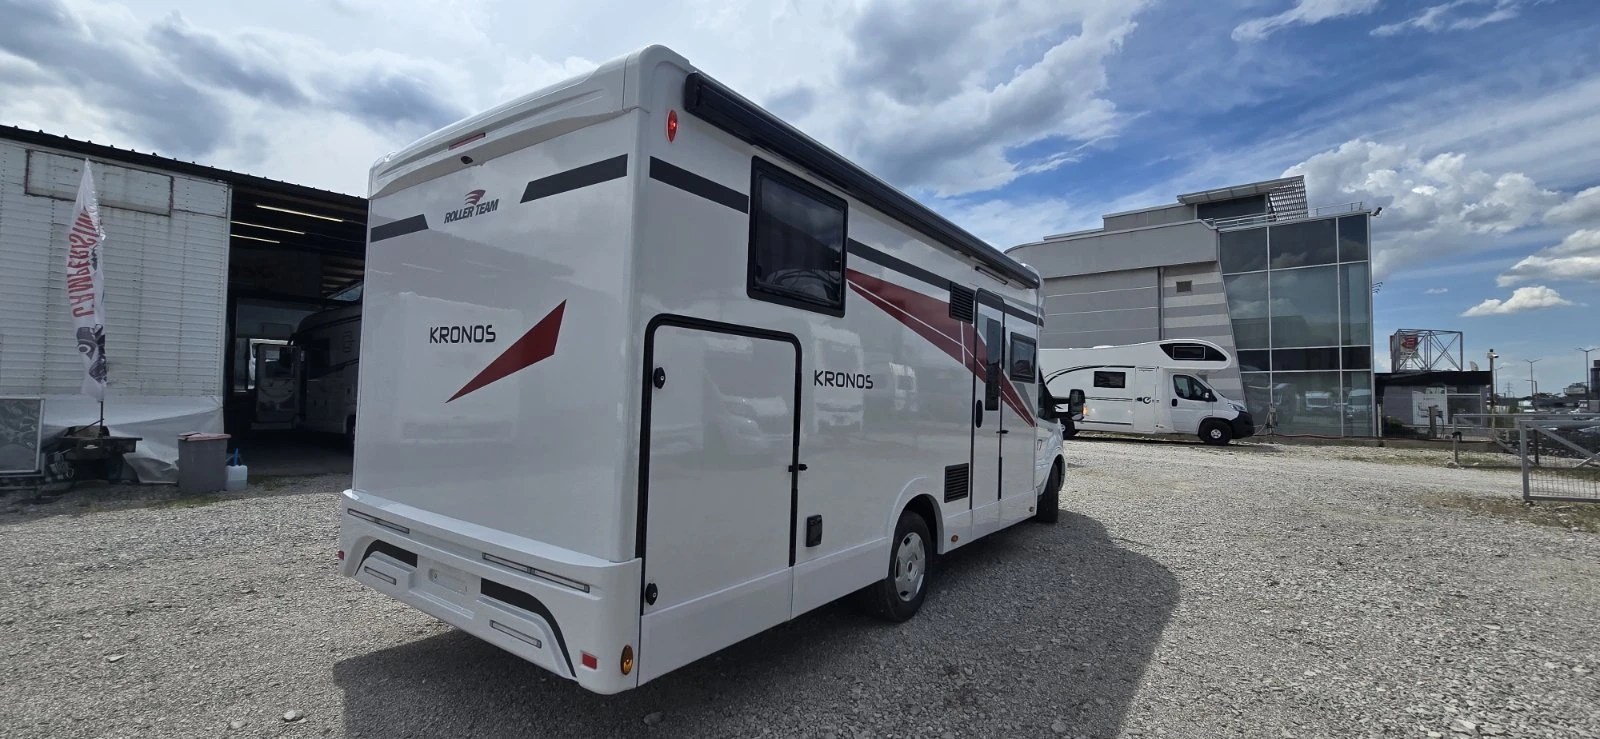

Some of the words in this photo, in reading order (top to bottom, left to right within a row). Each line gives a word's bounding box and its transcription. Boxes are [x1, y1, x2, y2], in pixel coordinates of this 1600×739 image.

[444, 206, 474, 224] ROLLER
[475, 199, 500, 216] TEAM
[429, 324, 496, 344] KRONOS
[814, 369, 873, 389] KRONOS
